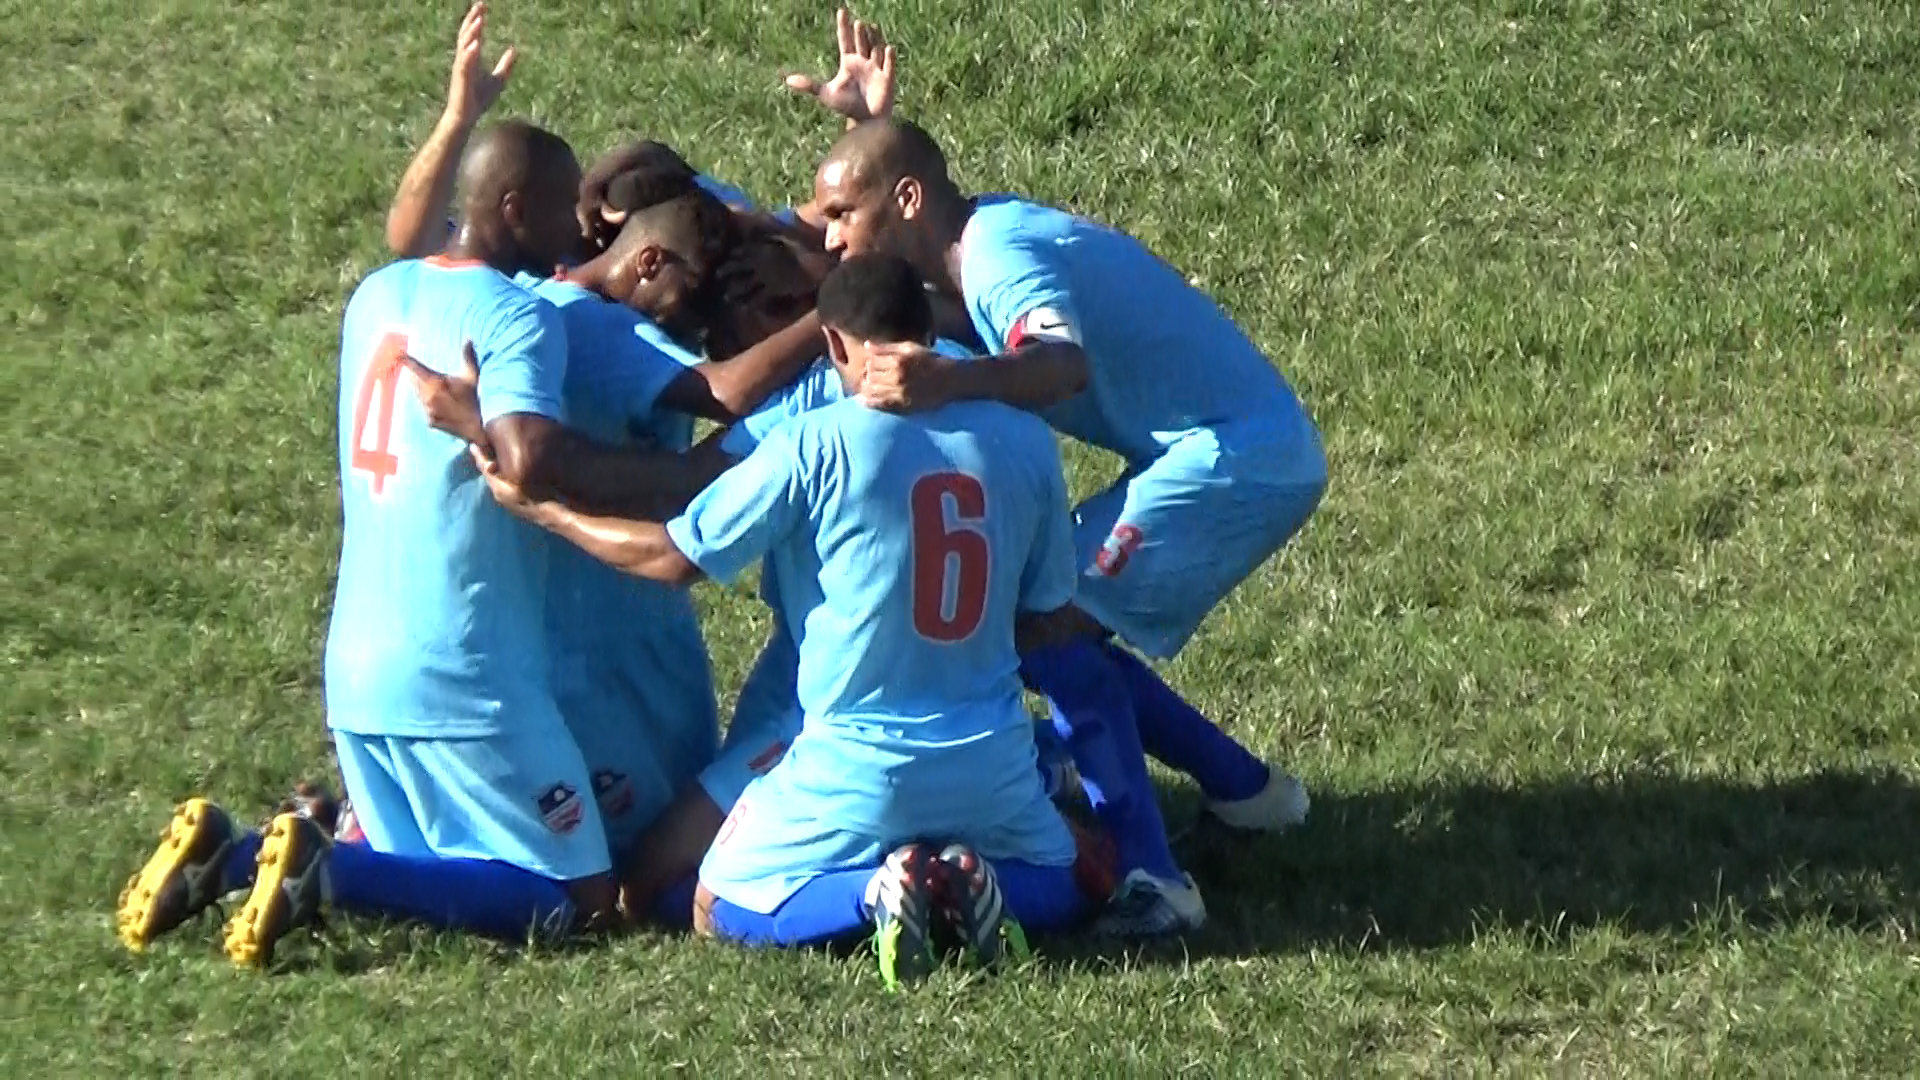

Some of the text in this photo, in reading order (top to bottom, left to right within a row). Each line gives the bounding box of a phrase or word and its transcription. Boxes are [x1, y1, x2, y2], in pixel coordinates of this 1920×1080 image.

[352, 332, 408, 495] 4
[910, 472, 989, 642] 6
[1096, 525, 1143, 576] 3
